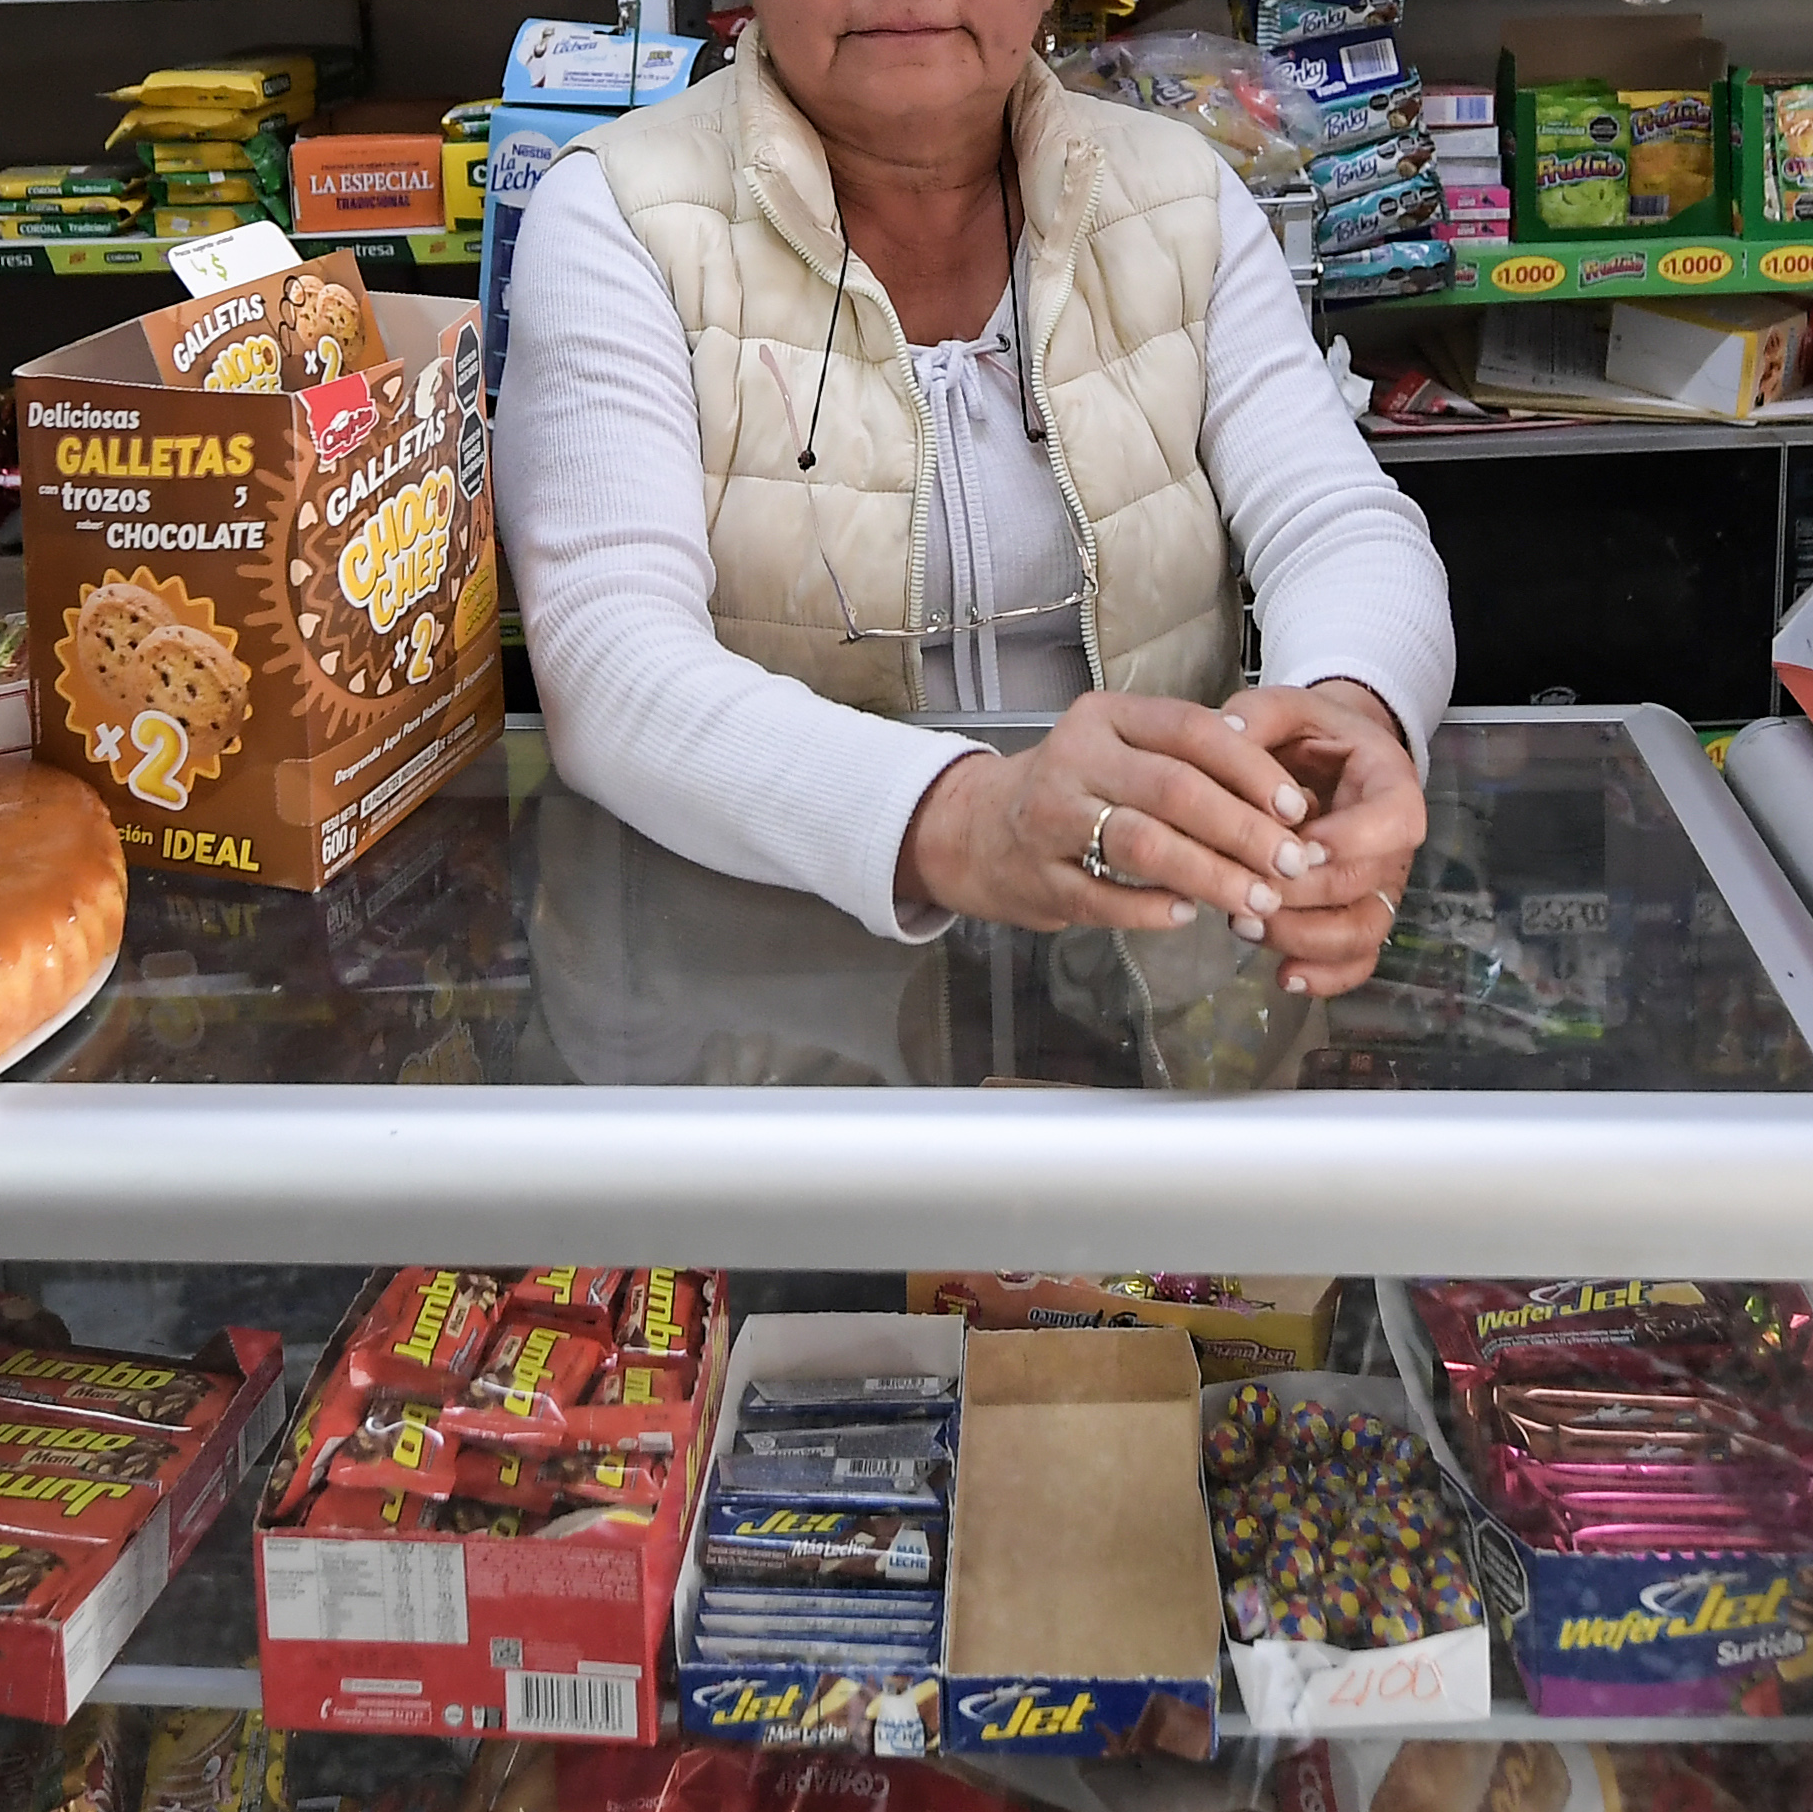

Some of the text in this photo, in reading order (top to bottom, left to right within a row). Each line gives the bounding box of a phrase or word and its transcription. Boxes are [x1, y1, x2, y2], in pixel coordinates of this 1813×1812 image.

[310, 171, 434, 194] LA ESPECIAL
[336, 196, 411, 210] TRADICIONAL
[20, 223, 62, 235] CORONA
[173, 294, 264, 371] GALLETAS
[28, 402, 139, 430] Deliciosas
[57, 436, 254, 477] GALLETAS
[327, 409, 446, 527] GALLETAS
[61, 483, 151, 513] trozos
[106, 522, 264, 550] CHOCOLATE
[343, 468, 454, 593] CHOCO
[372, 534, 448, 632] CHEF
[162, 829, 261, 873] IDEAL
[323, 829, 347, 864] 600
[1477, 1281, 1653, 1338] Wafer Jet
[736, 1509, 844, 1534] Jet
[888, 1556, 926, 1570] LECHE
[1561, 1581, 1790, 1652] Wafer Jet
[712, 1685, 802, 1725] Jet
